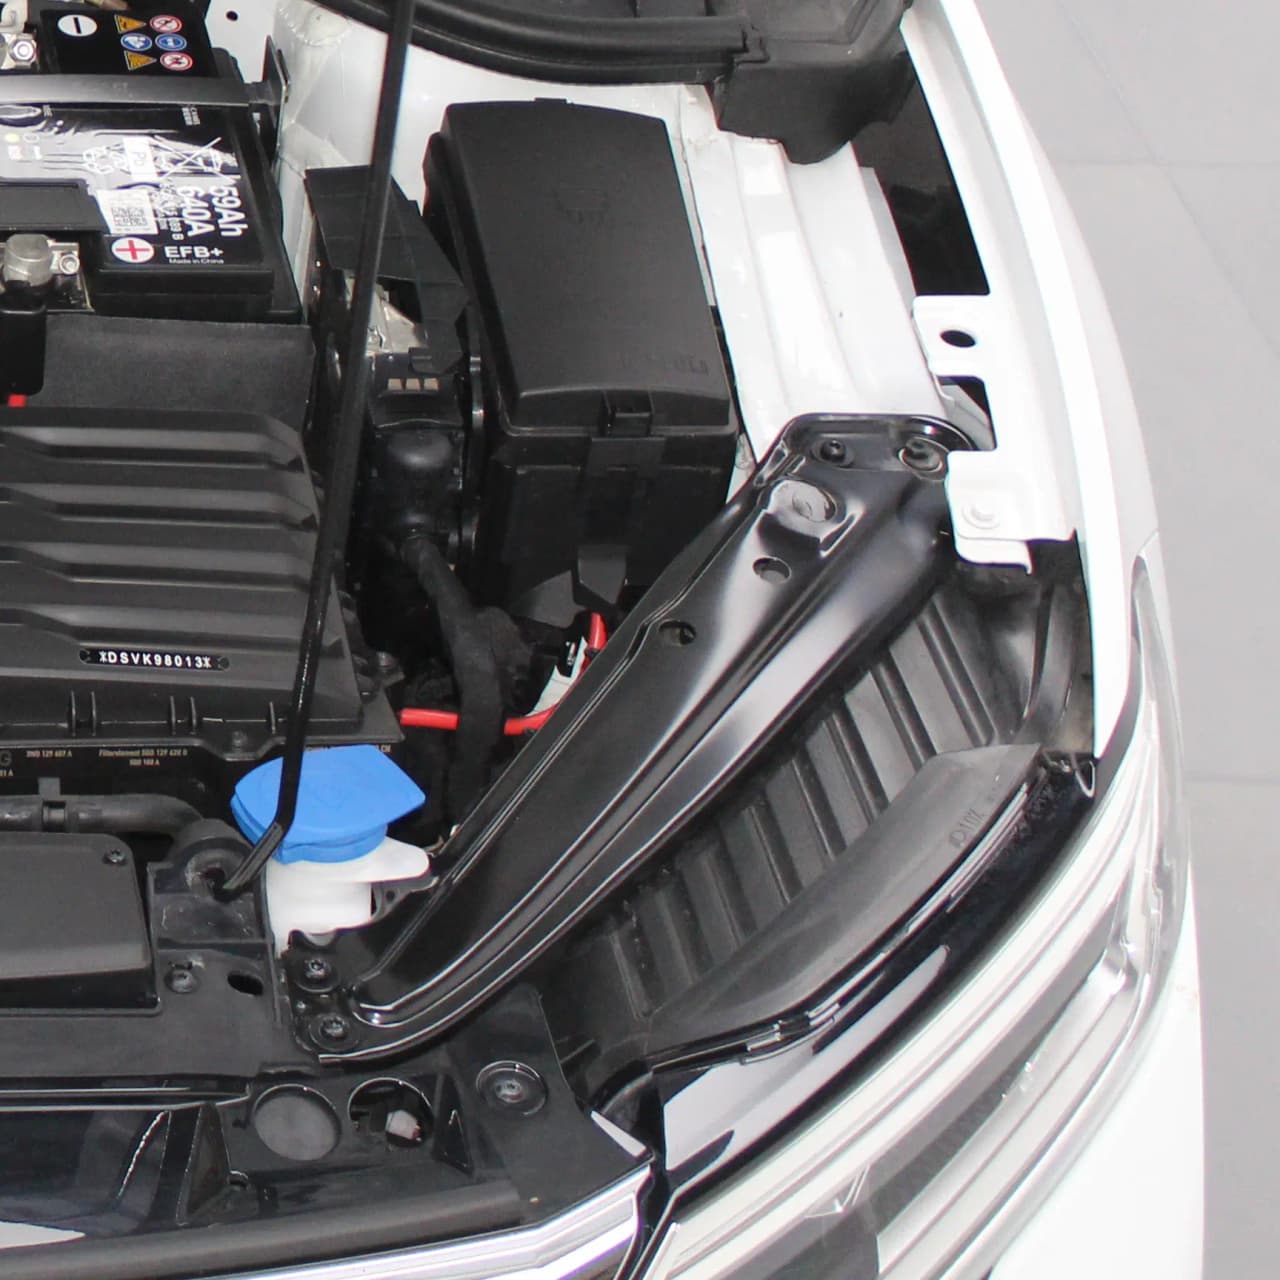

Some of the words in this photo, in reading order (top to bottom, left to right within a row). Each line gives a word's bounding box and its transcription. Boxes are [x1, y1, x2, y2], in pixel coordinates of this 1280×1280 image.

[178, 185, 215, 237] 640A
[209, 185, 249, 237] 59Ah
[164, 245, 224, 259] EFB+
